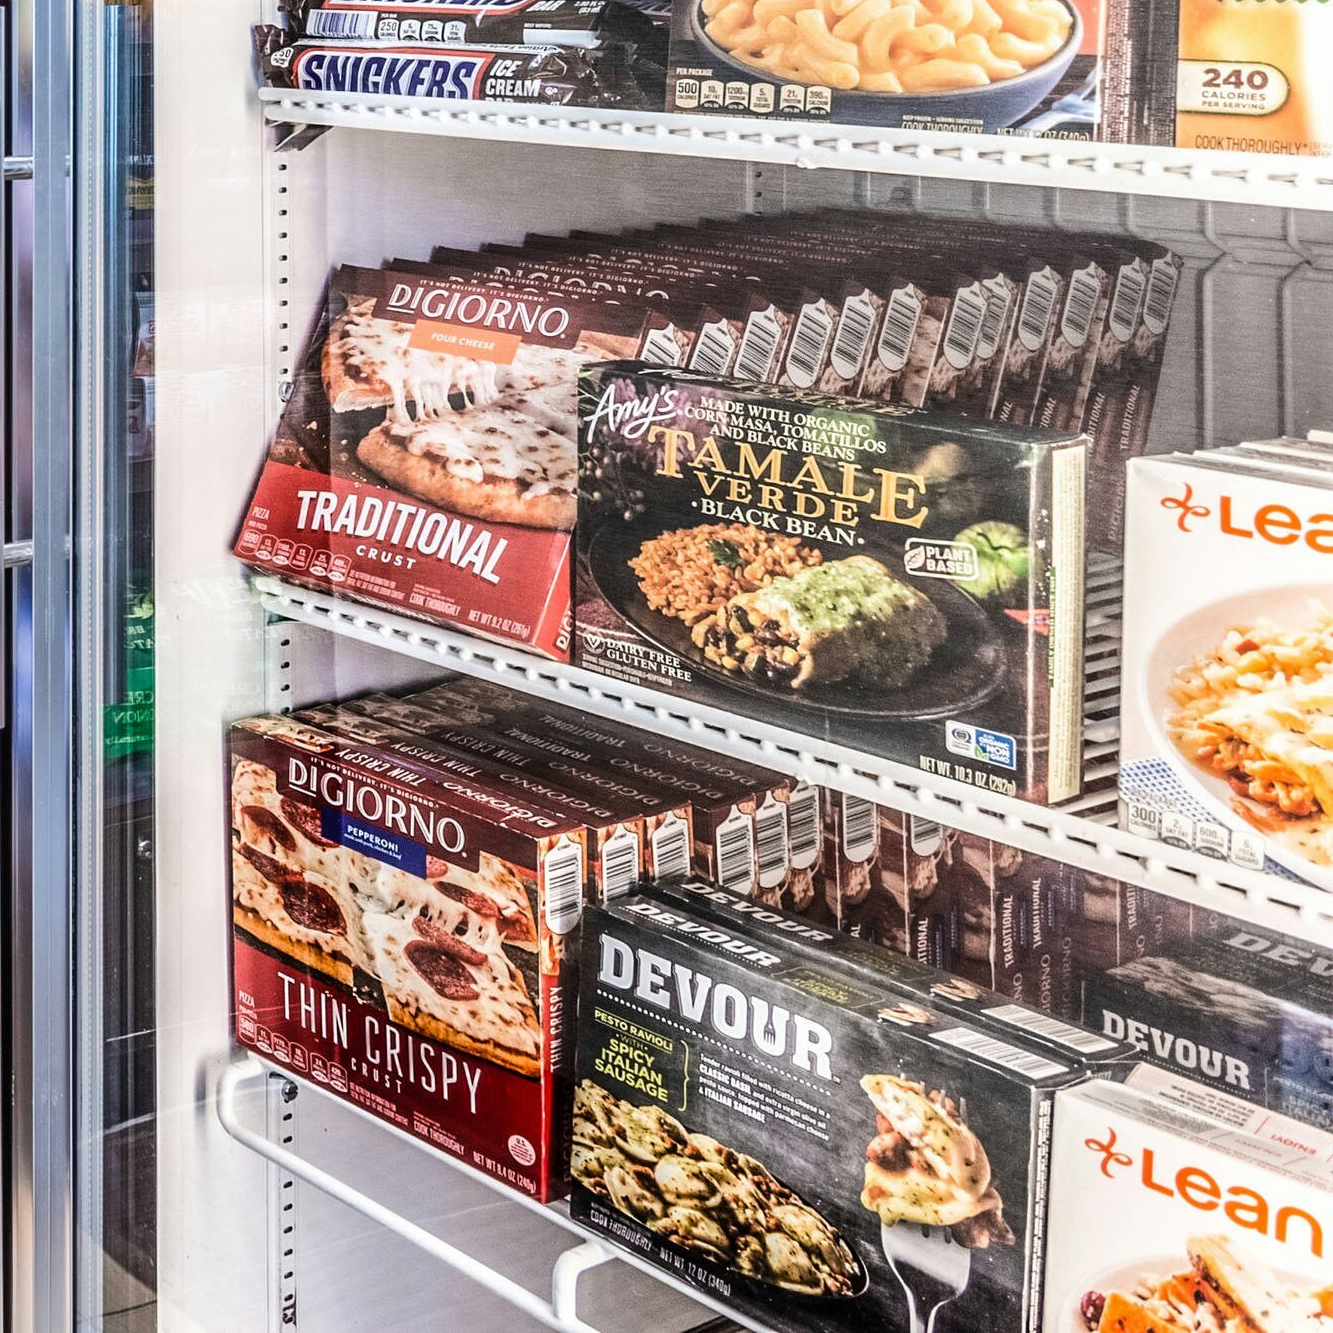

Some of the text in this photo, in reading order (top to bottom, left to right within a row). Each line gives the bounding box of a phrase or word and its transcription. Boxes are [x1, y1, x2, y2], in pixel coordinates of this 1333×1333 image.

[303, 55, 477, 99] SNICKERS
[489, 59, 522, 76] ICE
[1202, 68, 1269, 89] 240
[485, 79, 540, 96] CREAM
[1202, 90, 1266, 101] CALORIES
[431, 332, 495, 351] FOUR CHEESE
[584, 384, 678, 443] Amy's
[684, 406, 729, 422] CORN
[781, 424, 887, 453] TOMATILLOS
[700, 397, 870, 437] MADE WITH ORGANIC
[710, 422, 855, 461] AND BLACK BEANS
[647, 425, 929, 529] TAMALE
[694, 471, 859, 526] VERDE
[297, 490, 509, 585] TRADITIONAL
[356, 544, 417, 569] CRUST
[926, 545, 972, 564] PLANT
[926, 558, 974, 576] BASED
[606, 650, 657, 672] GLUTEN
[661, 664, 692, 682] FREE
[607, 639, 681, 668] DAIRY FREE
[347, 825, 398, 852] PEPPERONI
[596, 932, 836, 1083] DEVOUR
[277, 971, 349, 1050] THIN
[365, 1016, 483, 1115] CRISPY
[593, 1009, 673, 1052] PESTO RAVIOLI
[1102, 1009, 1251, 1090] DEVOUR
[600, 1048, 663, 1086] ITALIAN
[608, 1038, 656, 1069] SPICY
[594, 1058, 669, 1104] SAUSAGE
[1141, 1148, 1323, 1259] Lean
